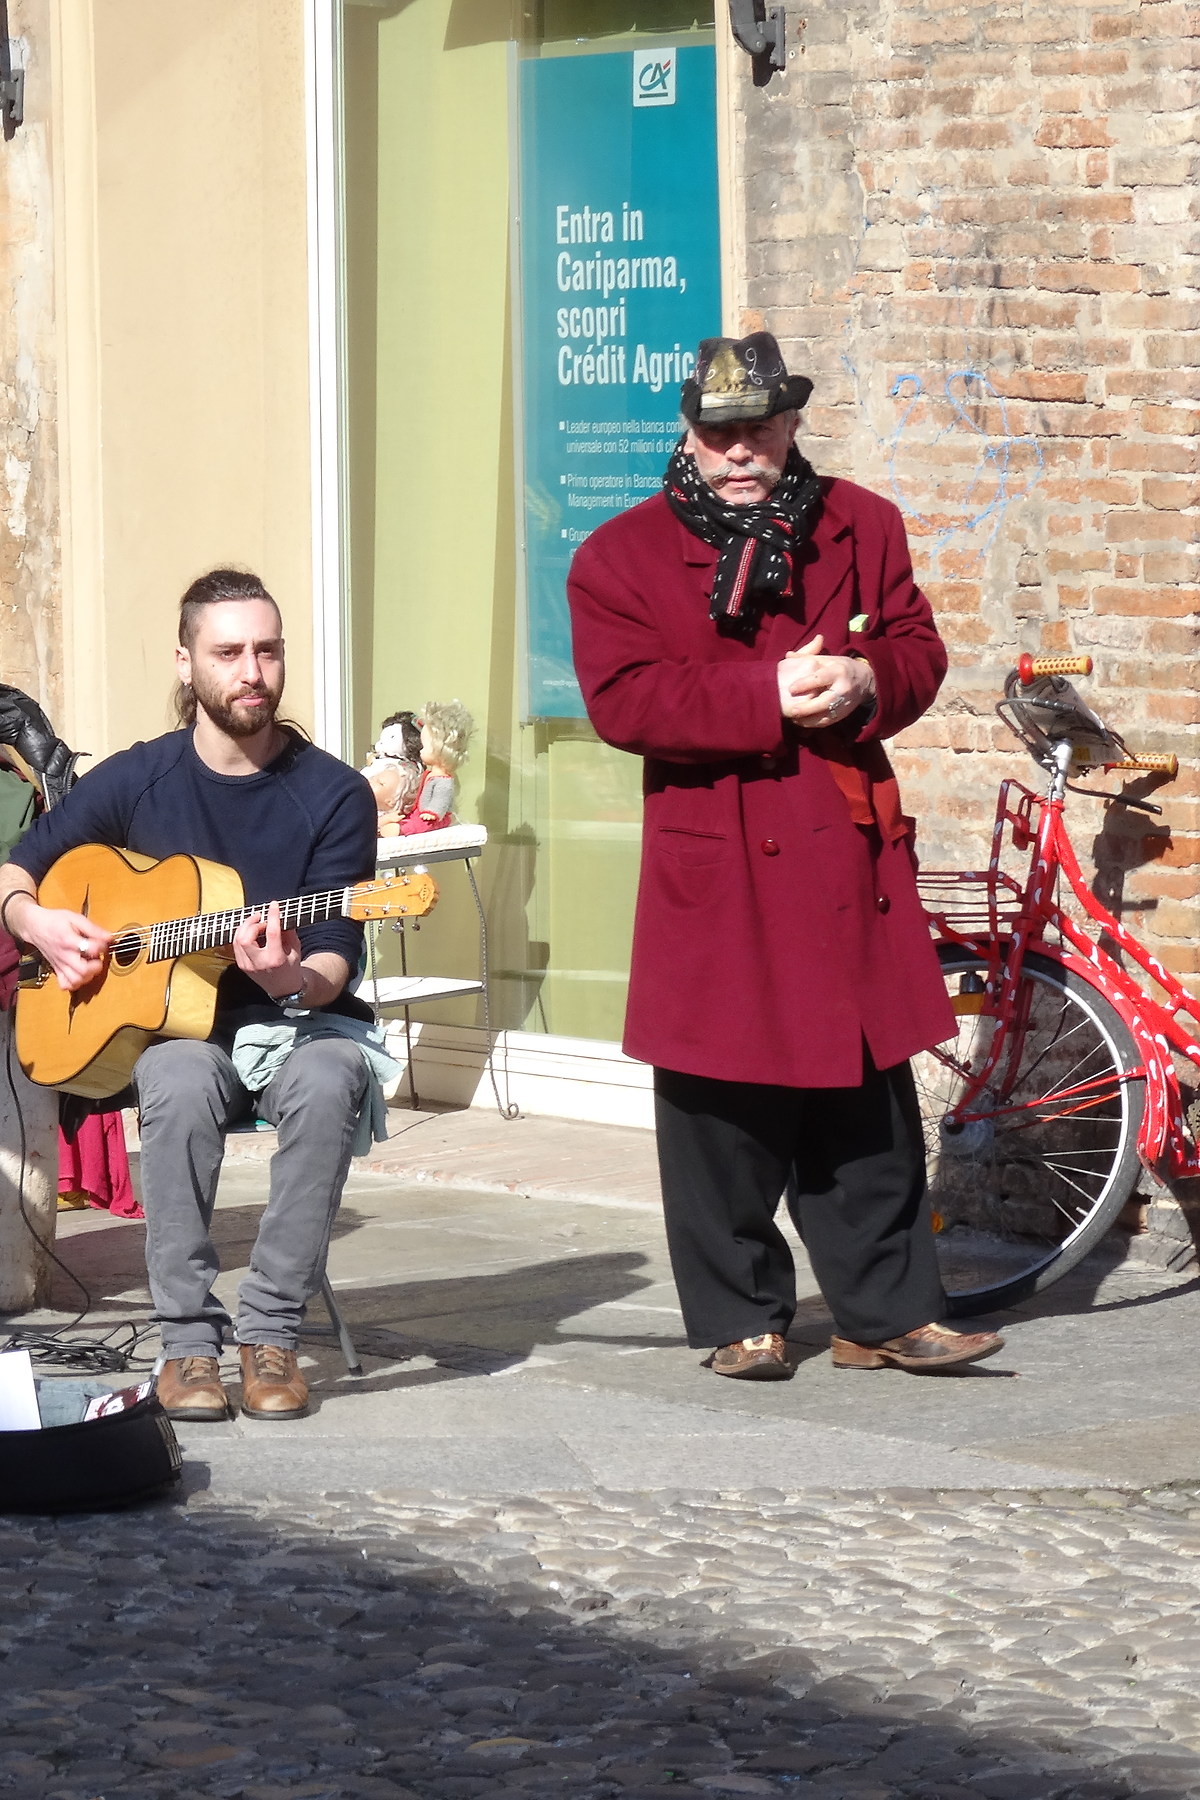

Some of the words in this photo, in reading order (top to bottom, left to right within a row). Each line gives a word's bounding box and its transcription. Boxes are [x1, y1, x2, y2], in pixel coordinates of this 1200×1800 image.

[556, 204, 613, 246] Entra
[622, 202, 644, 241] in
[556, 251, 687, 299] Cariparma,
[556, 298, 626, 346] scopri
[557, 341, 626, 387] Crédit
[633, 343, 695, 393] Agric
[566, 420, 590, 434] Leader
[593, 422, 620, 436] europeo
[622, 419, 640, 434] nella
[641, 419, 664, 434] banca
[566, 440, 602, 453] universale
[603, 441, 617, 453] con
[619, 438, 629, 453] 52
[630, 438, 655, 453] milioni
[656, 438, 664, 453] di
[567, 473, 588, 488] Primo
[590, 475, 624, 490] operatore
[625, 474, 633, 488] in
[568, 493, 614, 510] Management
[616, 493, 623, 507] in
